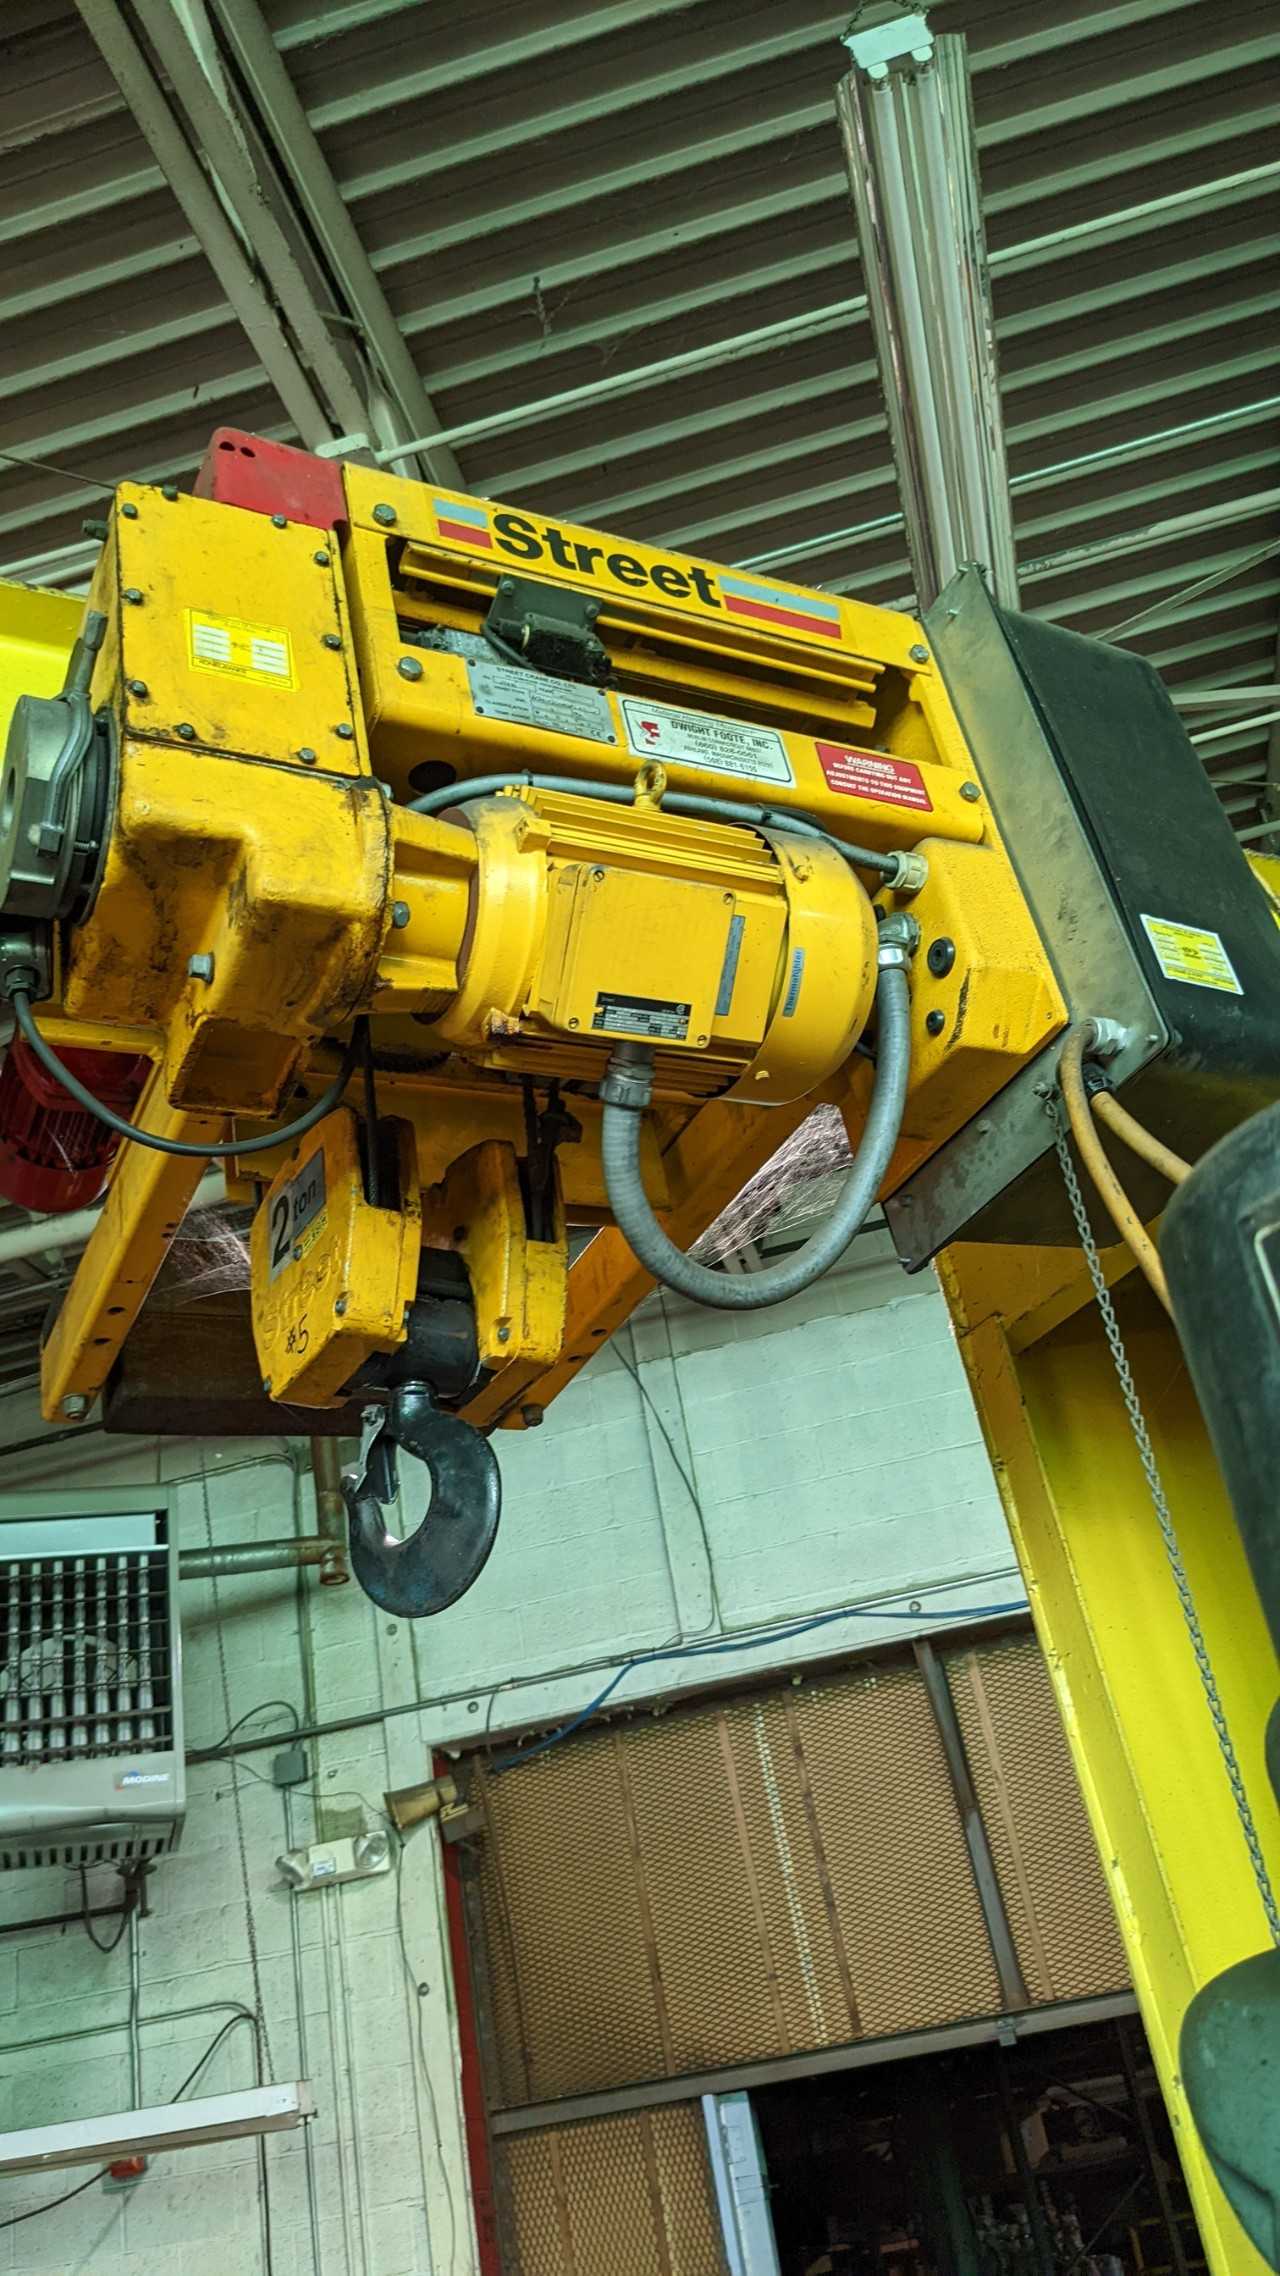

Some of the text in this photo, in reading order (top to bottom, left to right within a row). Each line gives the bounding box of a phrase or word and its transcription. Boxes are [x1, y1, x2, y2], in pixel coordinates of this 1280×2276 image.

[493, 513, 722, 608] Street
[671, 720, 710, 737] DWIGHT
[713, 730, 750, 746] FOOTE,
[752, 738, 774, 750] INC.
[272, 1194, 290, 1270] 2
[293, 1178, 317, 1220] ton
[285, 1312, 310, 1354] #5
